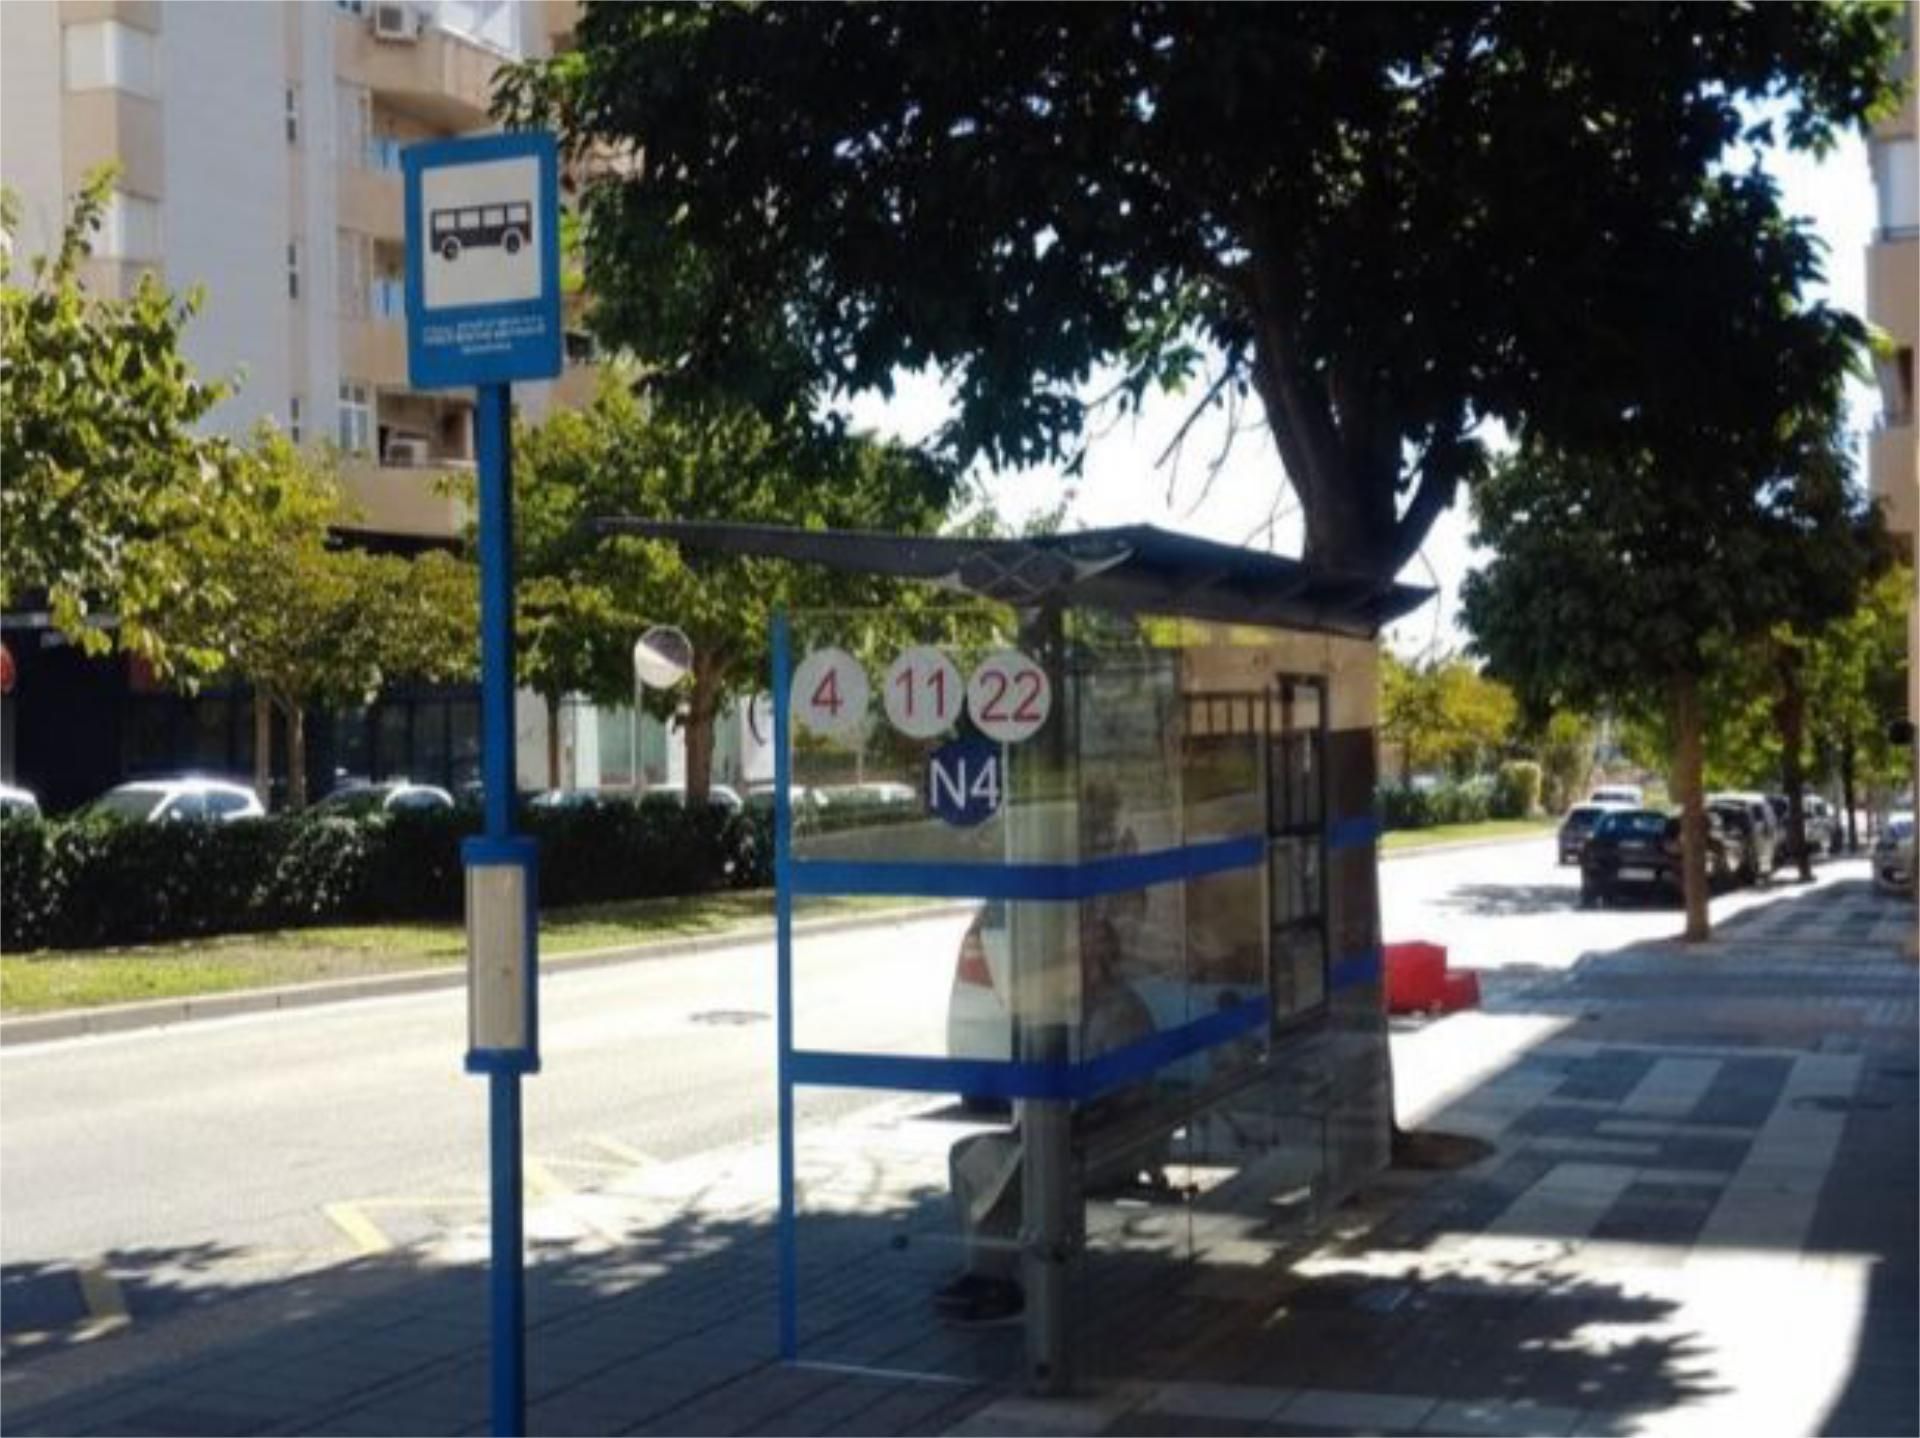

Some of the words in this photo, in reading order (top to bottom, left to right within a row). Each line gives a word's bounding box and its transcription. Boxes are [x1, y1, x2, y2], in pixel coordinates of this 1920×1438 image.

[811, 666, 844, 717] 4
[895, 667, 945, 718] 11
[979, 671, 1041, 722] 22
[929, 756, 999, 811] N4
